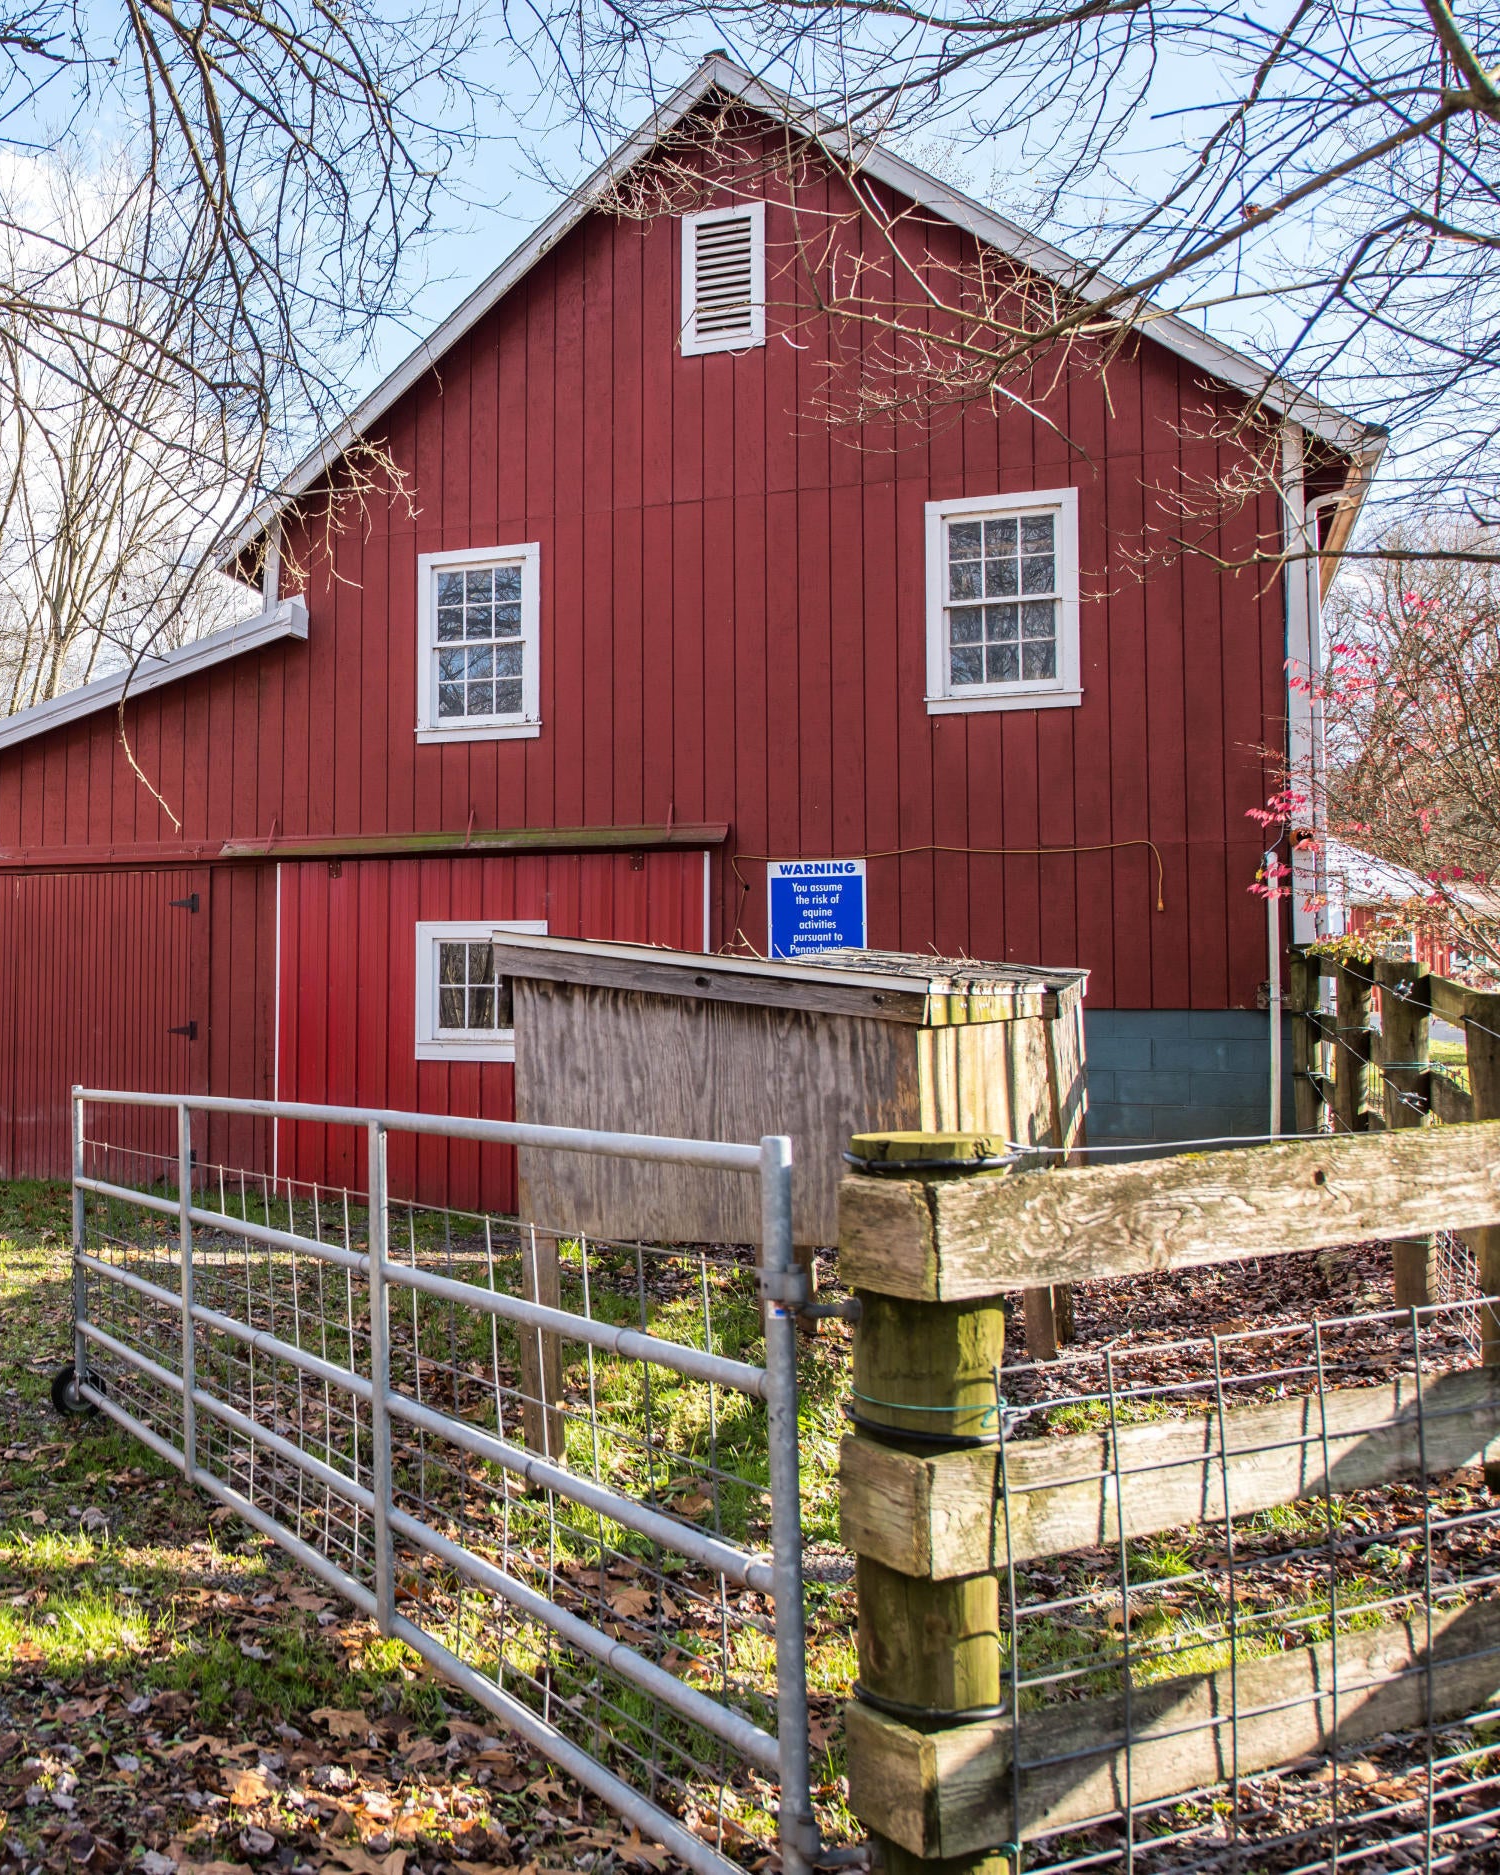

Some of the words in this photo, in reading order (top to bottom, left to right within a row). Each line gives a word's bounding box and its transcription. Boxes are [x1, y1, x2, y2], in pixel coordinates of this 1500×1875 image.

[779, 863, 856, 875] WARNING
[792, 883, 807, 892] You
[796, 896, 809, 904] the
[812, 895, 827, 904] risk
[831, 894, 839, 903] of
[803, 908, 832, 918] equine
[799, 921, 836, 929] activities
[793, 933, 831, 943] pursuant
[834, 933, 842, 941] to
[790, 944, 844, 954] Pennsylvani
